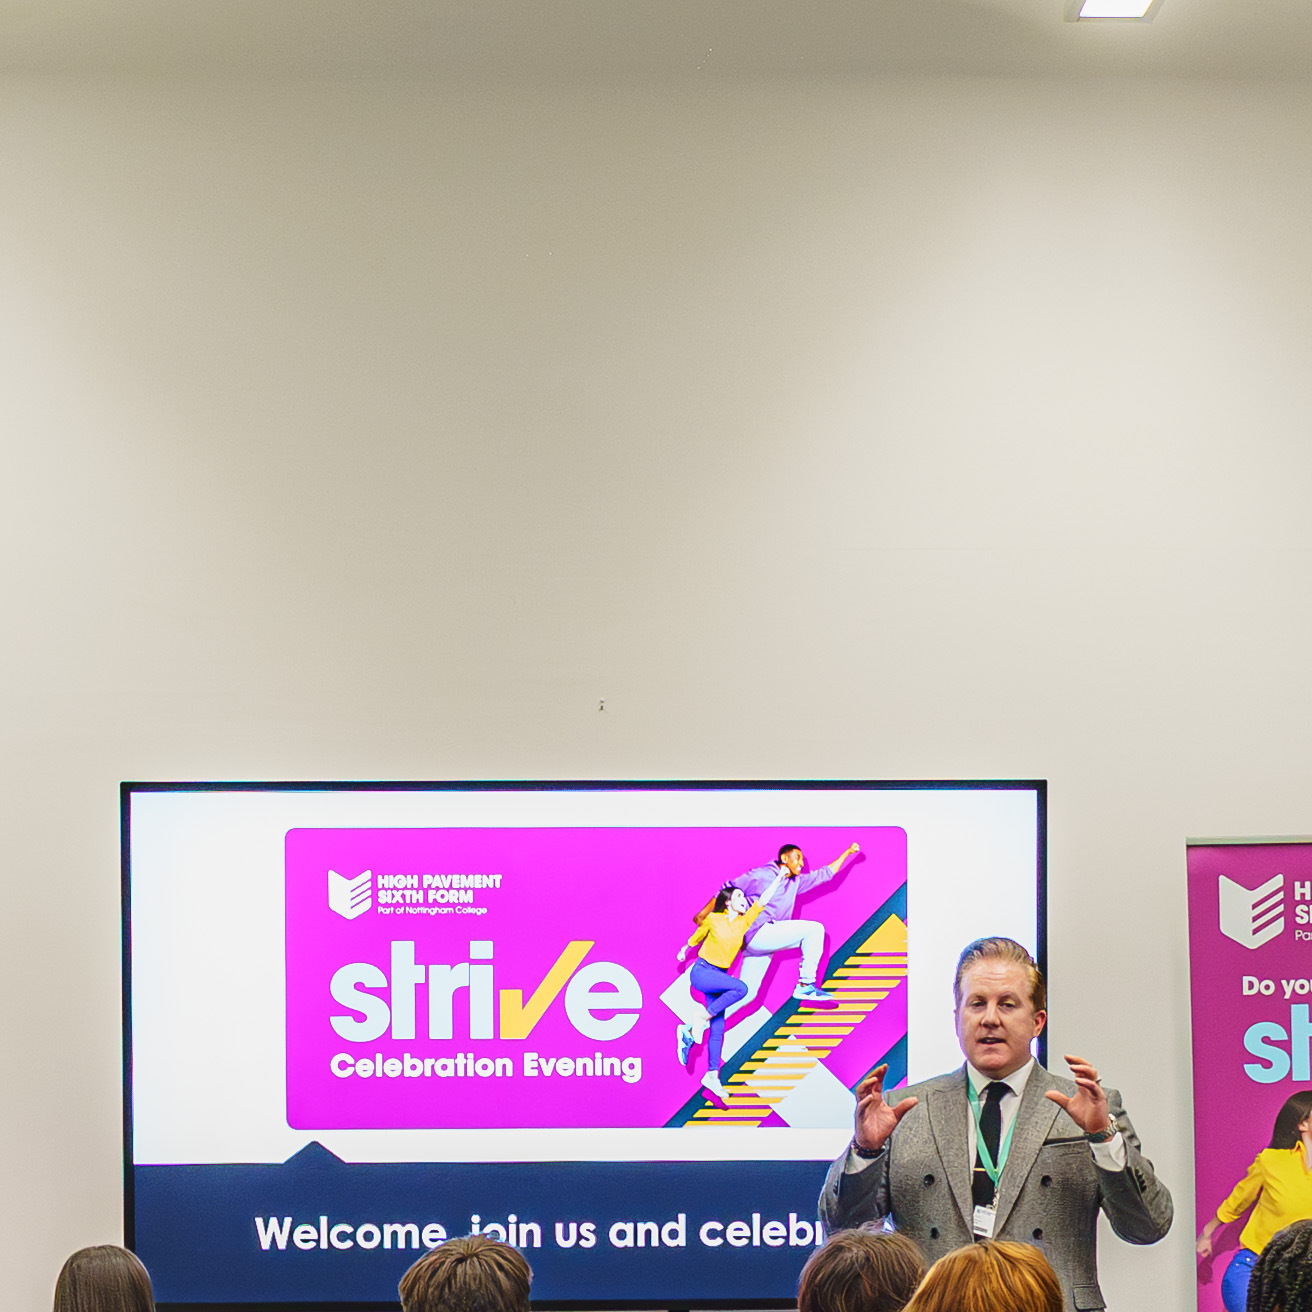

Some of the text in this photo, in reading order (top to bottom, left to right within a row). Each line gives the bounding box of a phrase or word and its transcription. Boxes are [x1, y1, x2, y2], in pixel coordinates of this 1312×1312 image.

[377, 873, 503, 889] HIGH PAVEMENT
[377, 889, 474, 905] SIXTH FORM
[377, 905, 488, 916] Part of Nottingham College
[329, 940, 643, 1043] strive
[1242, 975, 1276, 996] Do
[329, 1051, 642, 1084] Celebration Evening
[554, 1222, 597, 1248] us
[608, 1212, 687, 1248] and
